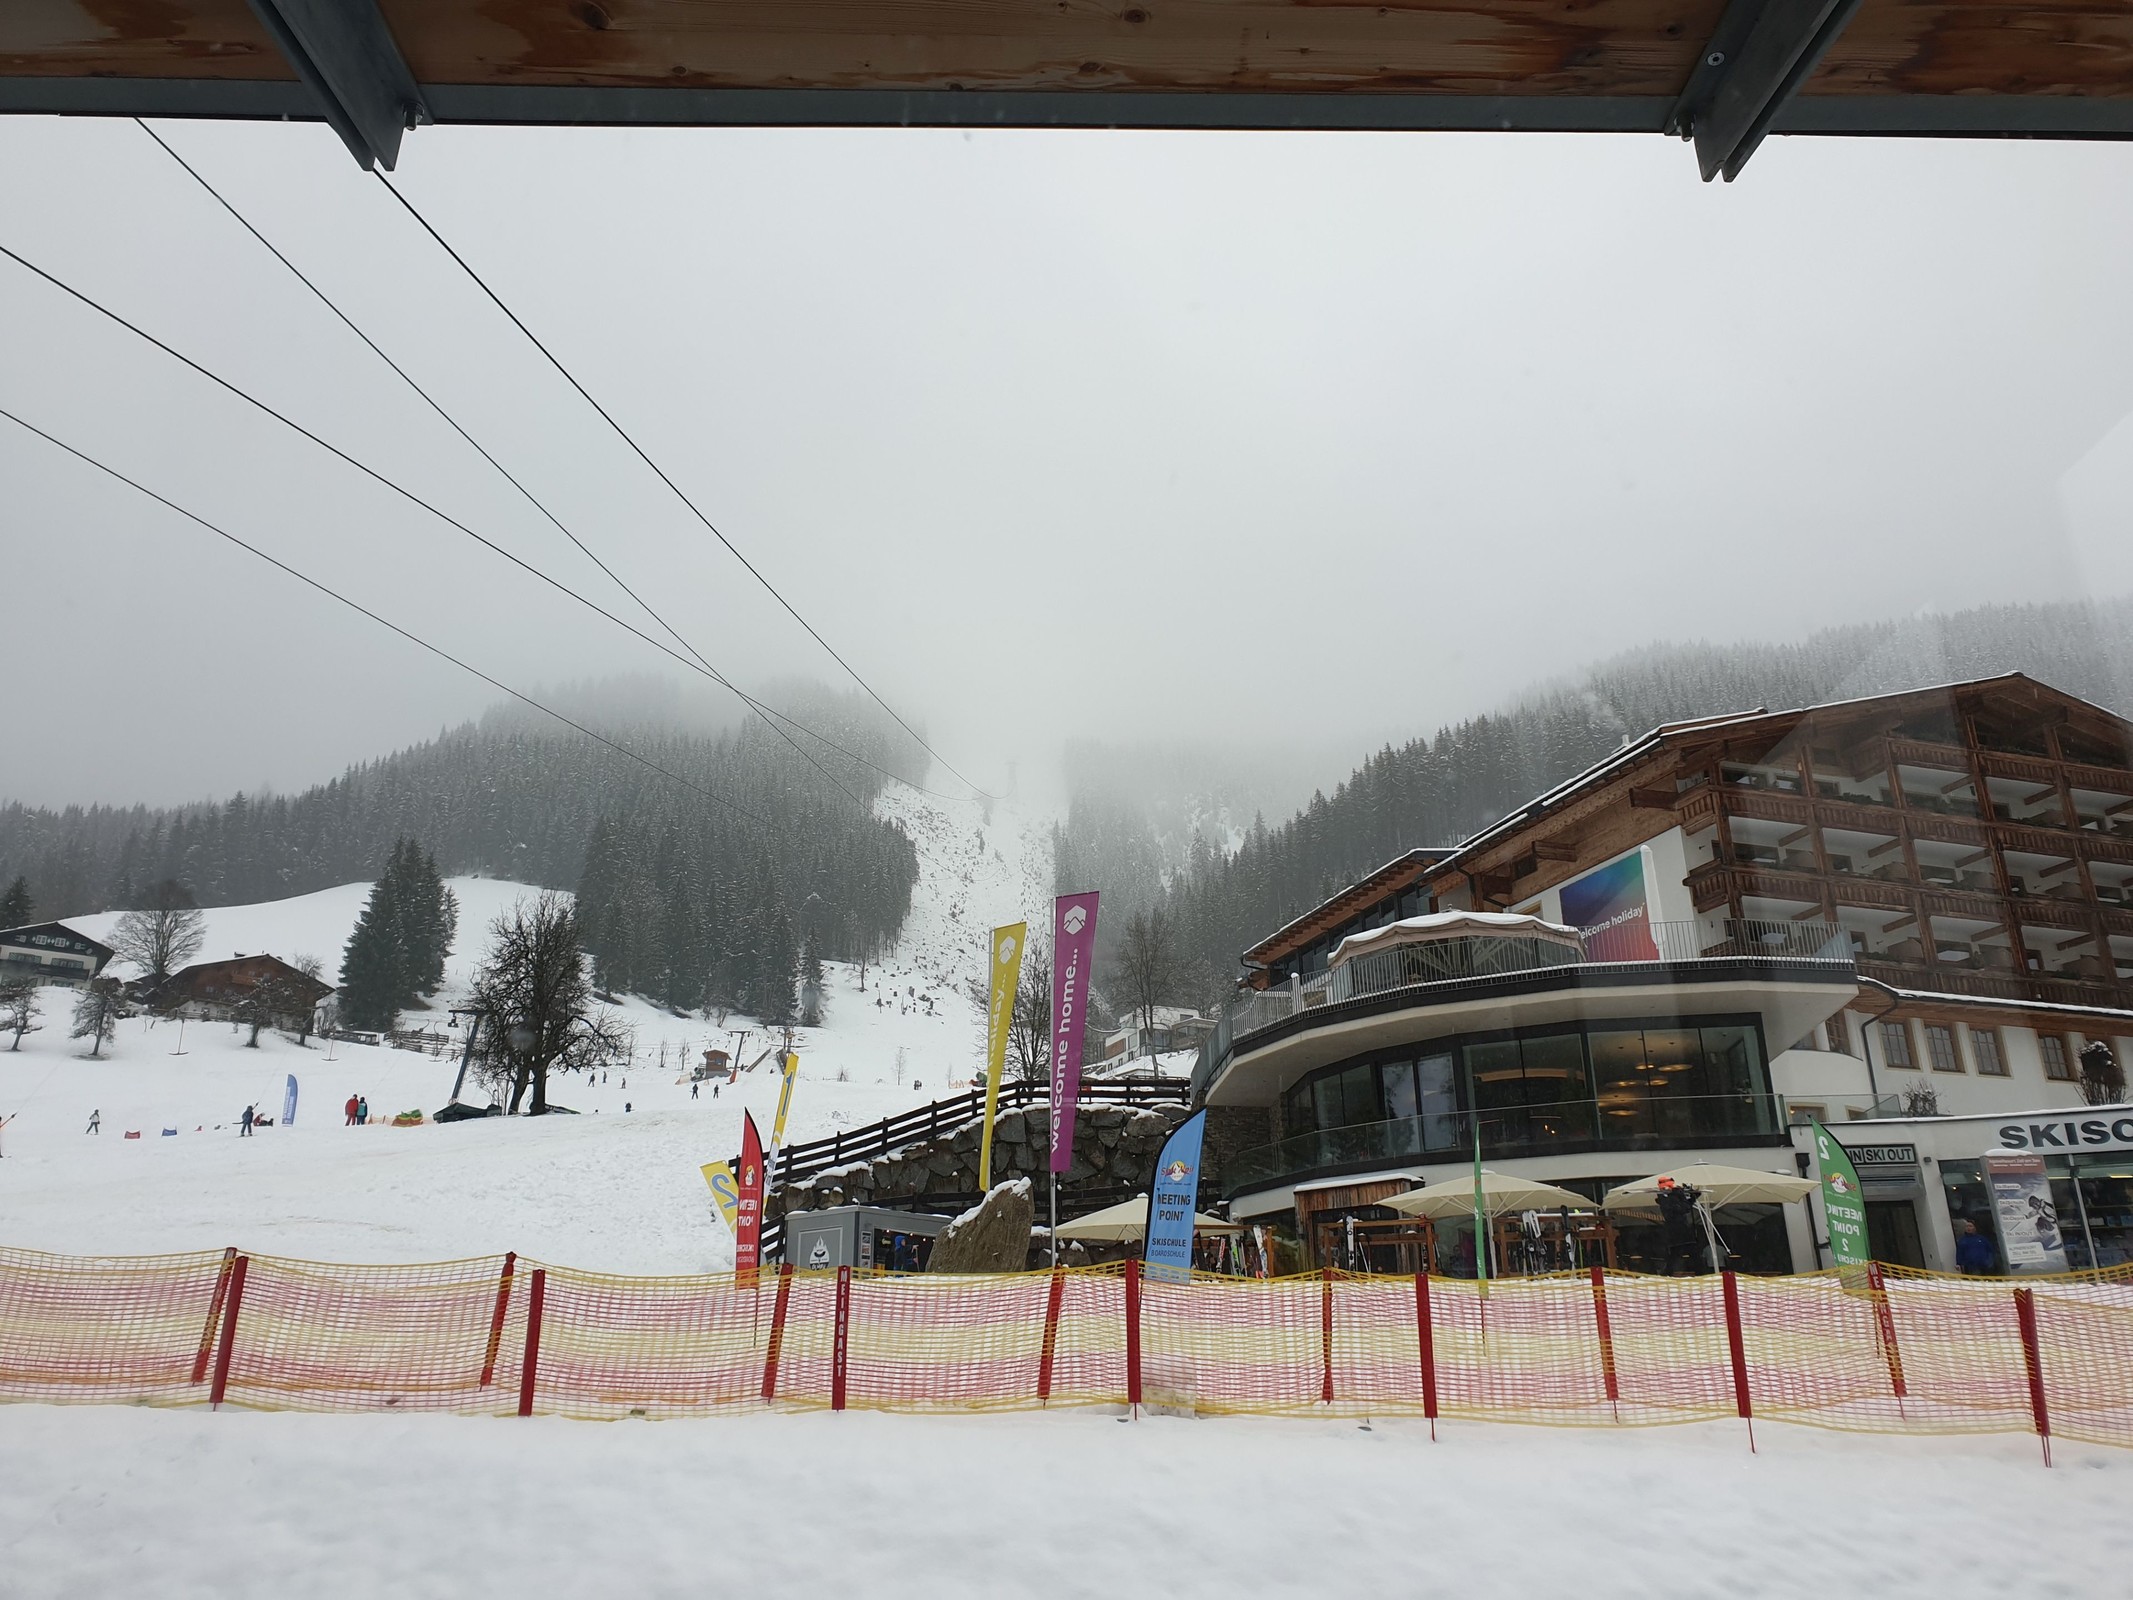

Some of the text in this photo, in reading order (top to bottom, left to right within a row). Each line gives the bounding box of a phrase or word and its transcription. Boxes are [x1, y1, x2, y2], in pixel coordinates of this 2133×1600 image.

[1579, 905, 1643, 940] elcome holiday
[1051, 1040, 1069, 1153] welcome
[1865, 1150, 1886, 1162] SKI
[1888, 1149, 1912, 1161] OUT
[1159, 1210, 1184, 1222] POINT
[1152, 1237, 1187, 1248] SKISCHULE
[1151, 1249, 1186, 1258] BOARDSCHULE
[837, 1270, 848, 1377] MEINGAST
